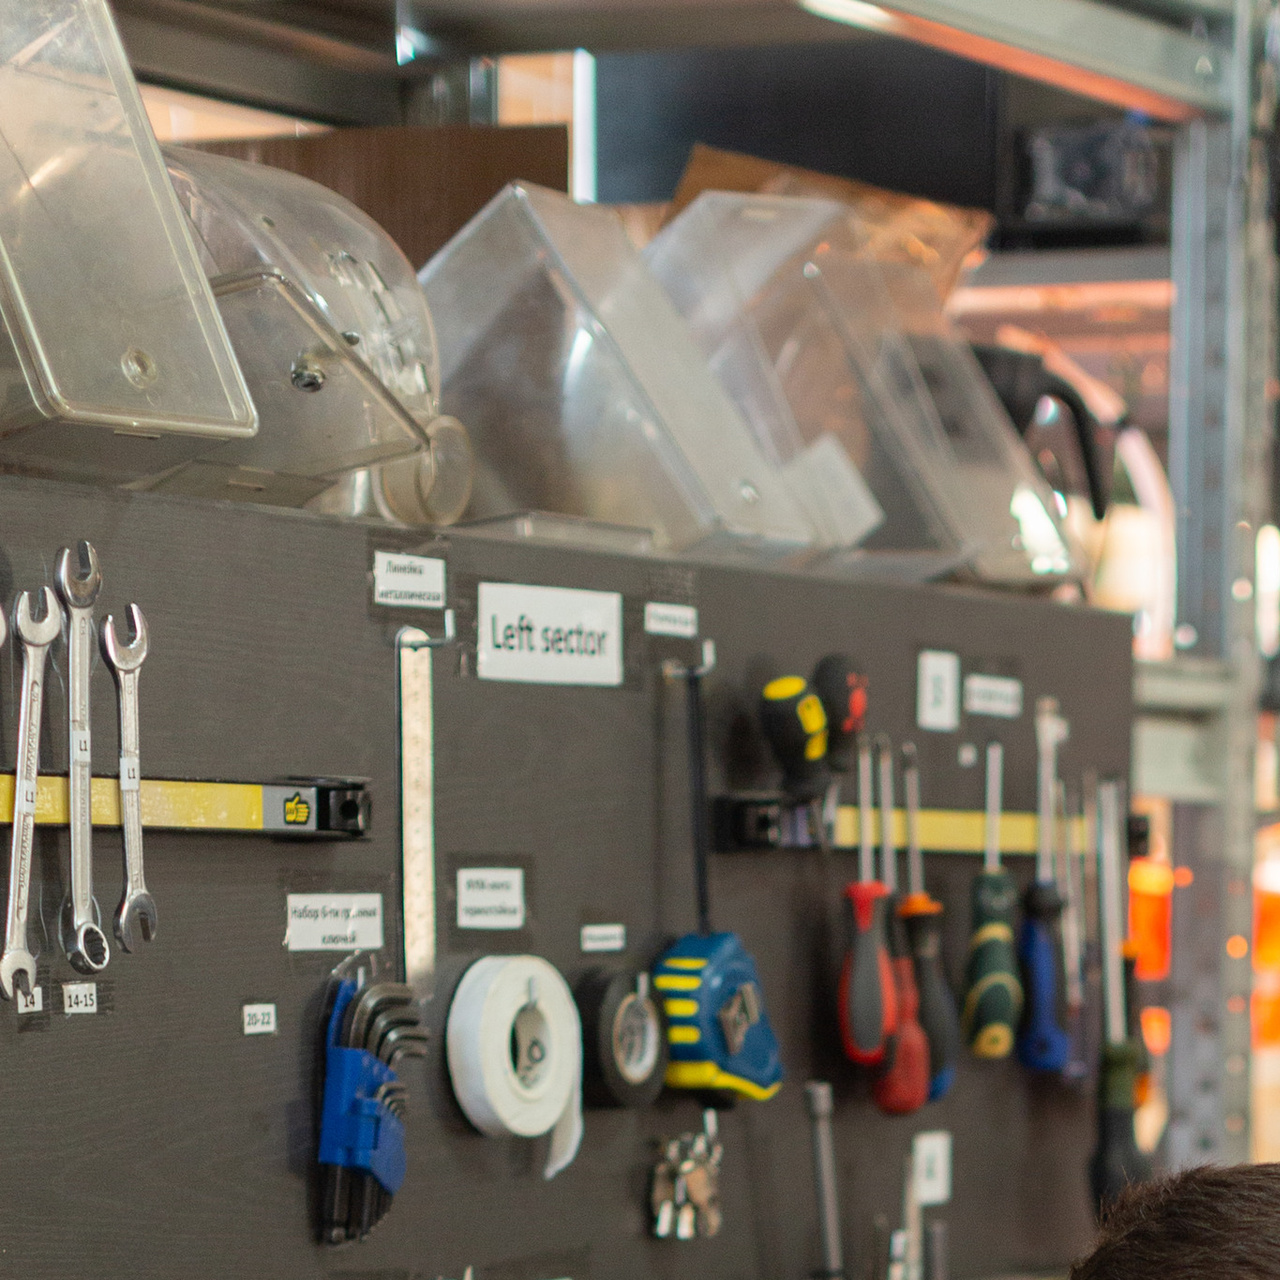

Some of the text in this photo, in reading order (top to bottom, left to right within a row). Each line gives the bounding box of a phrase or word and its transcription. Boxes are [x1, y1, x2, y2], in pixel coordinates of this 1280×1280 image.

[491, 614, 607, 656] Left sector
[24, 994, 35, 1008] 14
[67, 993, 95, 1008] 14-15
[246, 1012, 272, 1026] 20-22
